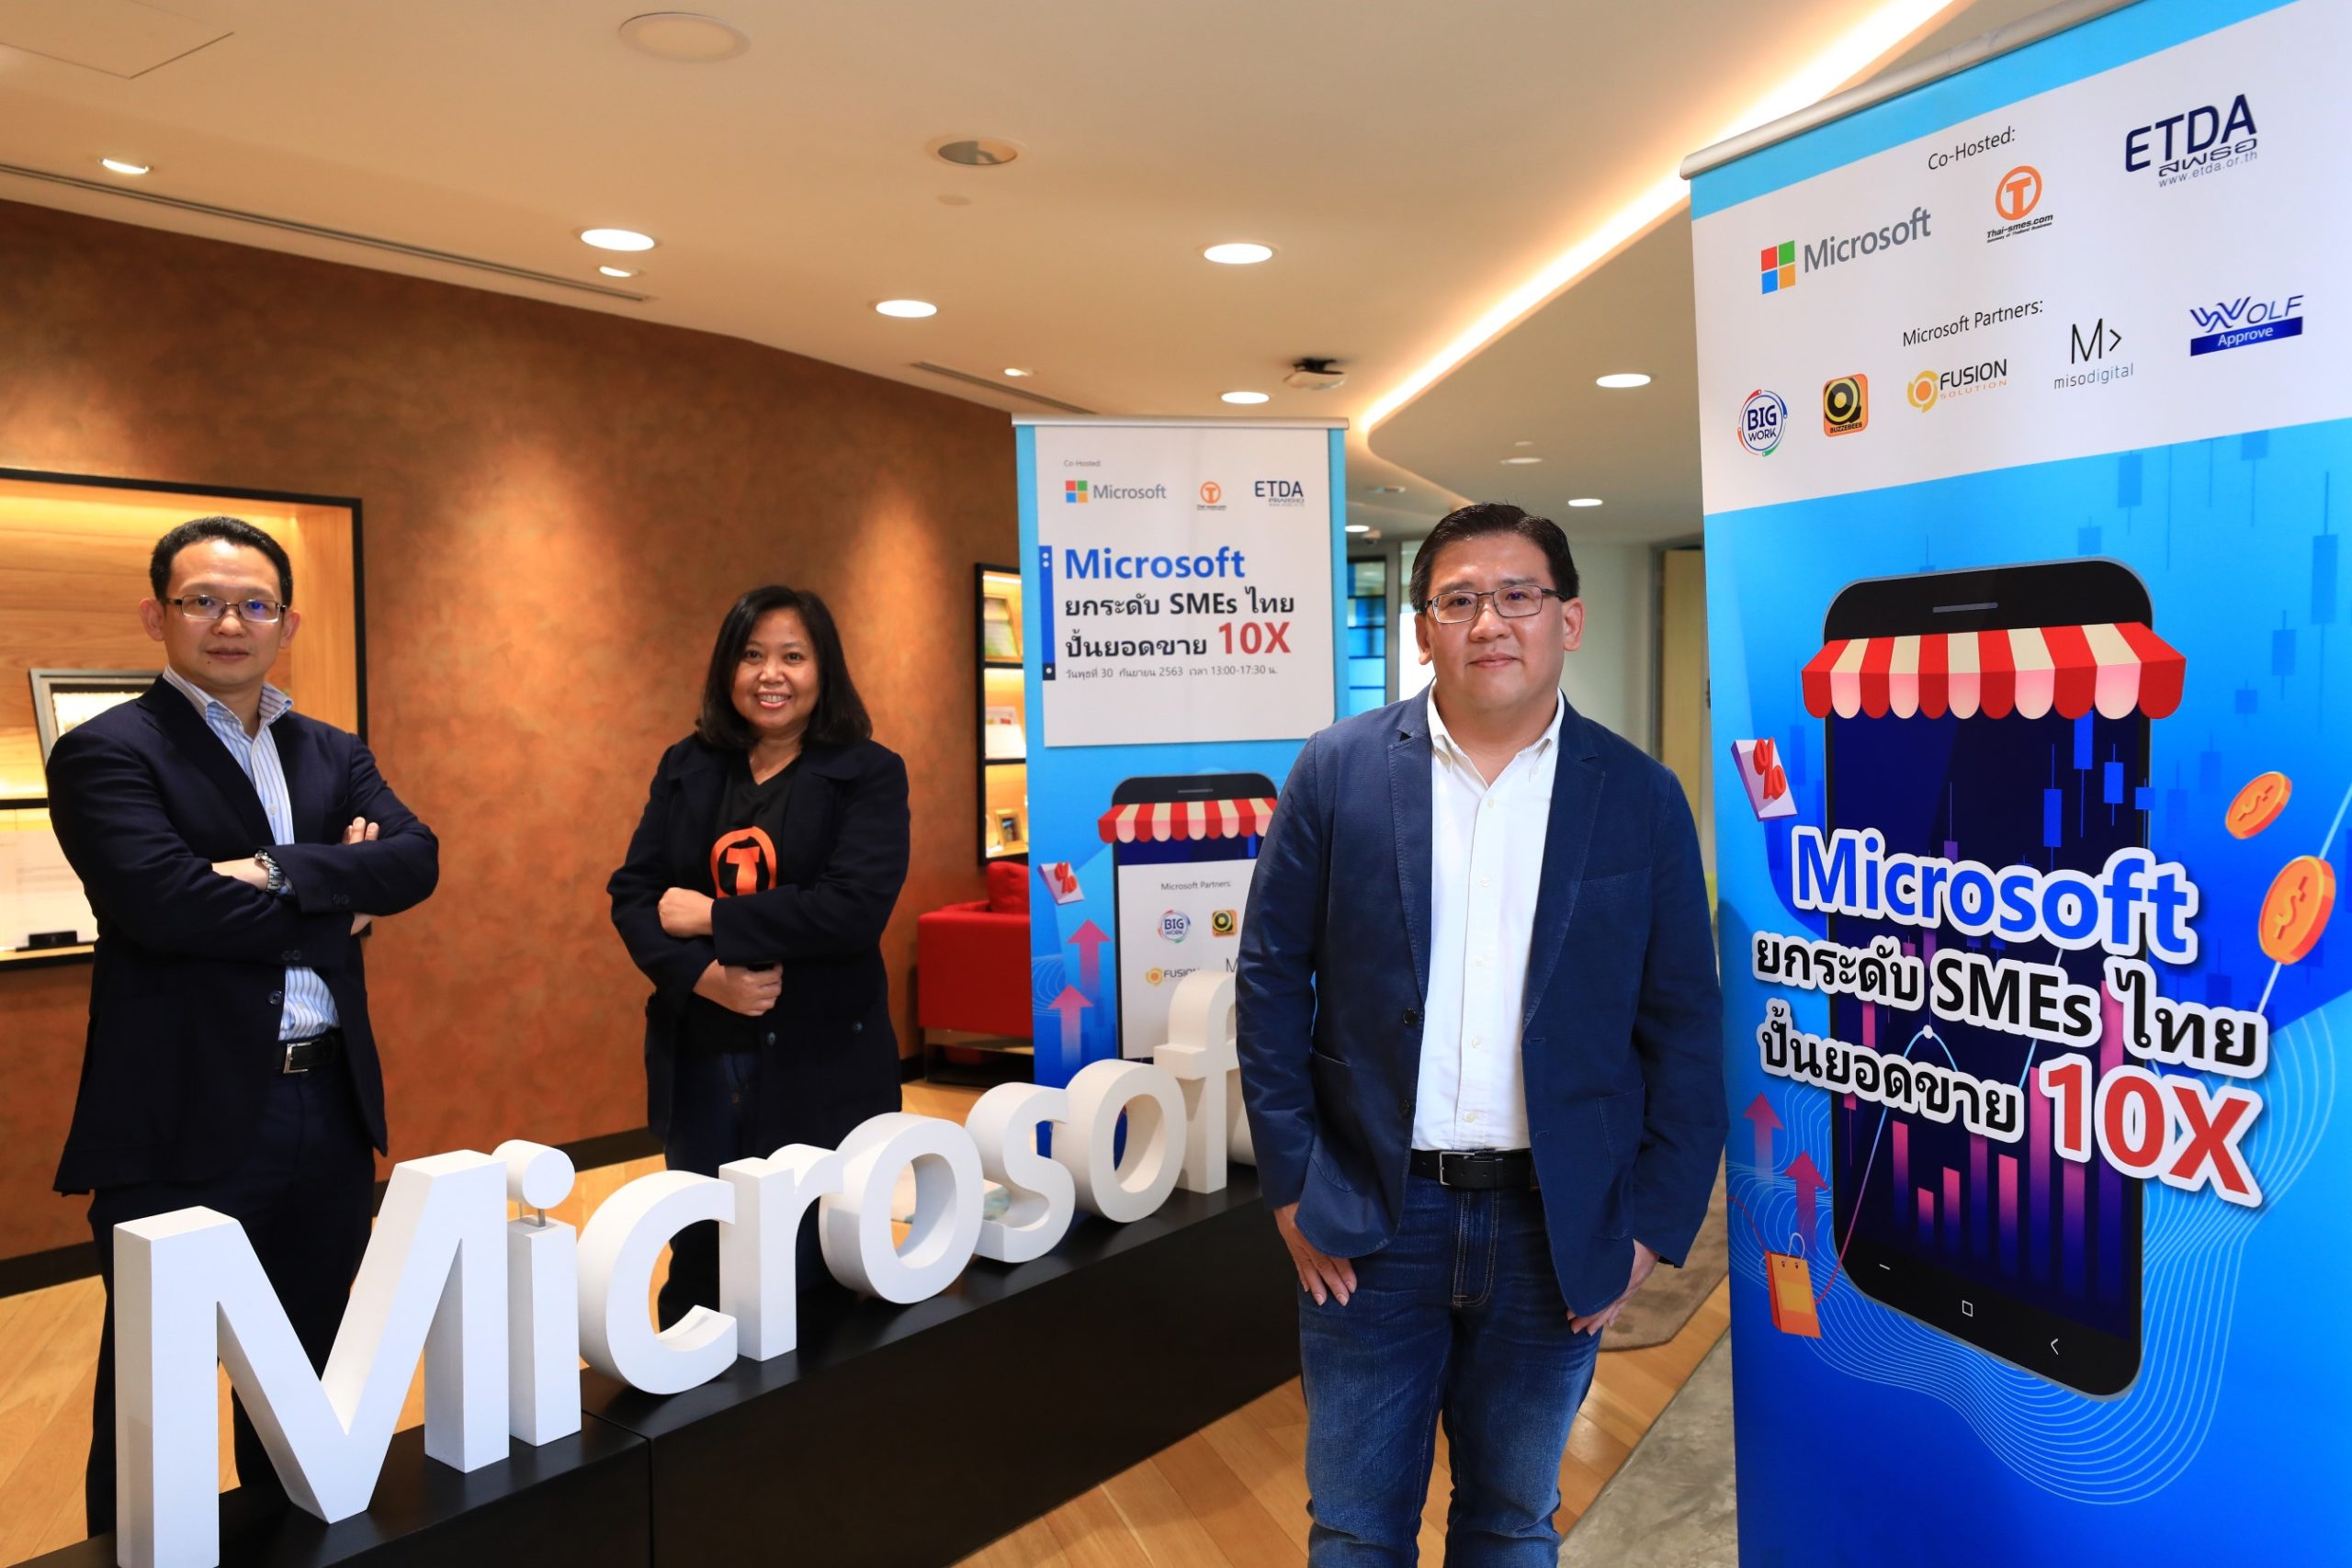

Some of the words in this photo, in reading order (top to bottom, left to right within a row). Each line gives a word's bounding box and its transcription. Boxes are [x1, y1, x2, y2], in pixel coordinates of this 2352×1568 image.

[1928, 126, 2016, 170] Co-Hosted:
[2126, 94, 2257, 172] ETDA
[2158, 151, 2257, 187] www.etda.or.th
[1804, 207, 1931, 273] Microsoft
[1986, 214, 2053, 239] Thai-smes.com
[1903, 316, 1970, 347] Microsoft
[1974, 300, 2043, 329] Partners:
[2218, 326, 2274, 347] Approve
[1939, 358, 2007, 390] FUSION
[2053, 363, 2134, 390] misodigital
[1939, 379, 2007, 400] SOLUTION
[1747, 404, 1778, 432] BIG
[1829, 422, 1863, 434] BUZZEBEES
[1748, 427, 1778, 443] WORK
[1093, 483, 1167, 500] Microsoft
[1254, 480, 1305, 497] ETDA
[1065, 547, 1246, 580] Microsoft
[1065, 592, 1160, 616] ยกระดับ
[1170, 592, 1238, 615] SMEs
[1245, 586, 1295, 614] ไทย
[1065, 629, 1208, 658] ปั้นยอดขาย
[1218, 621, 1292, 655] 10X
[1101, 668, 1114, 678] 30
[1159, 666, 1183, 677] 2563
[1211, 664, 1267, 676] 13:00-17:30
[1161, 881, 1198, 890] Microsoft
[1797, 833, 2190, 953] Microsoft
[1164, 919, 1184, 931] BIG
[1756, 935, 1919, 1001] ยกระดับ
[1936, 958, 2094, 1038] SMEs
[2113, 967, 2256, 1067] ไทย
[1760, 1004, 2018, 1134] ปั้นยอดขาย
[2048, 1062, 2252, 1196] 10X
[113, 971, 1258, 1568] Microsof
